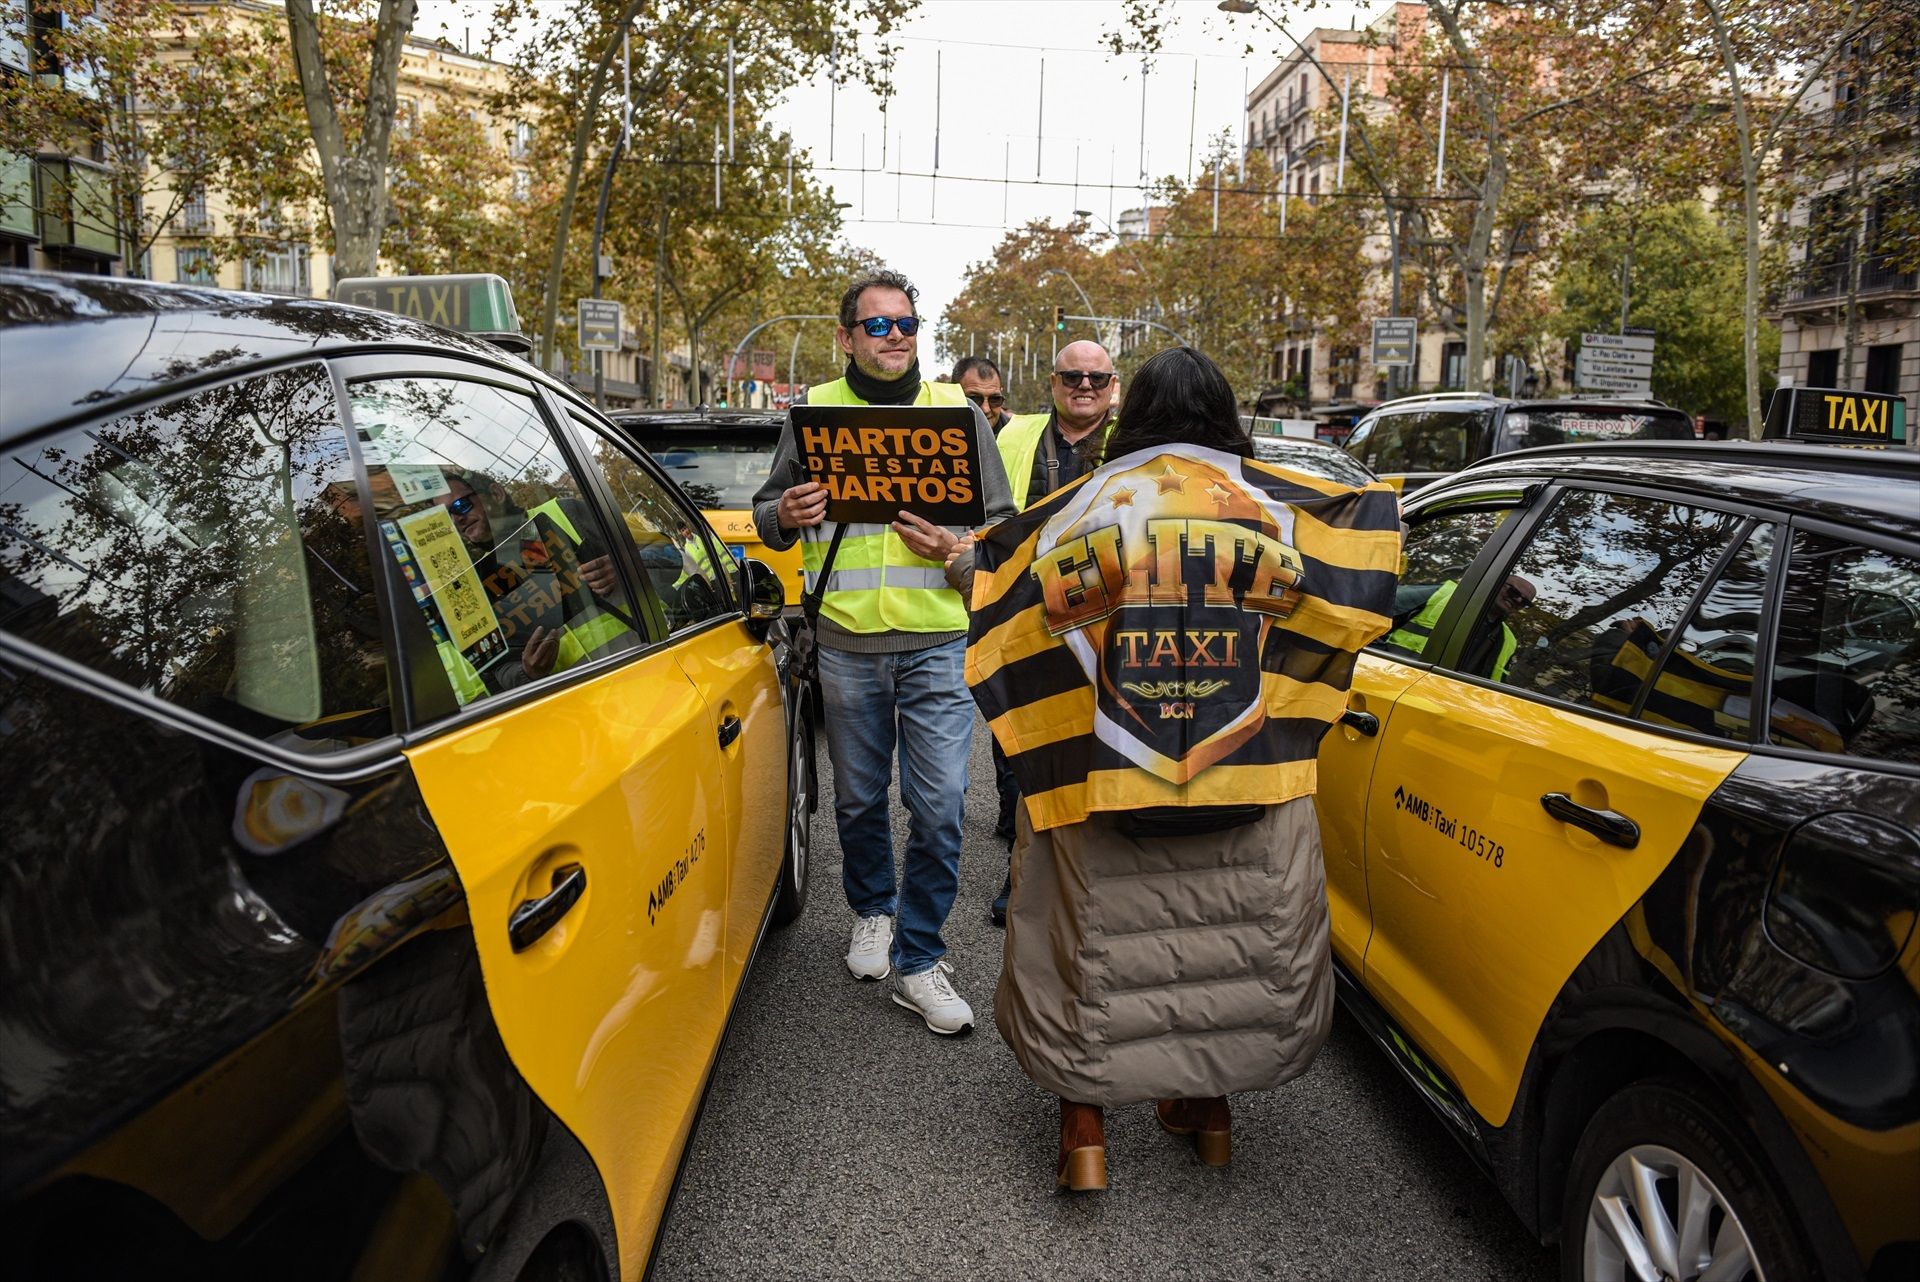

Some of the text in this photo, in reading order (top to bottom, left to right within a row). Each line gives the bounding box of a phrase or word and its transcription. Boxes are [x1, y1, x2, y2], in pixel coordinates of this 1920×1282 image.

[386, 284, 461, 326] TAXI
[1561, 419, 1626, 433] FREENOW
[1824, 395, 1888, 434] TAXI
[802, 426, 969, 456] HARTOS
[807, 456, 970, 475] DE ESTAR
[811, 474, 974, 504] HARTOS
[1030, 518, 1305, 637] ELITE
[1115, 630, 1240, 667] TAXI
[1159, 703, 1195, 719] BCN
[690, 828, 705, 863] 4276
[1460, 825, 1504, 868] 10578
